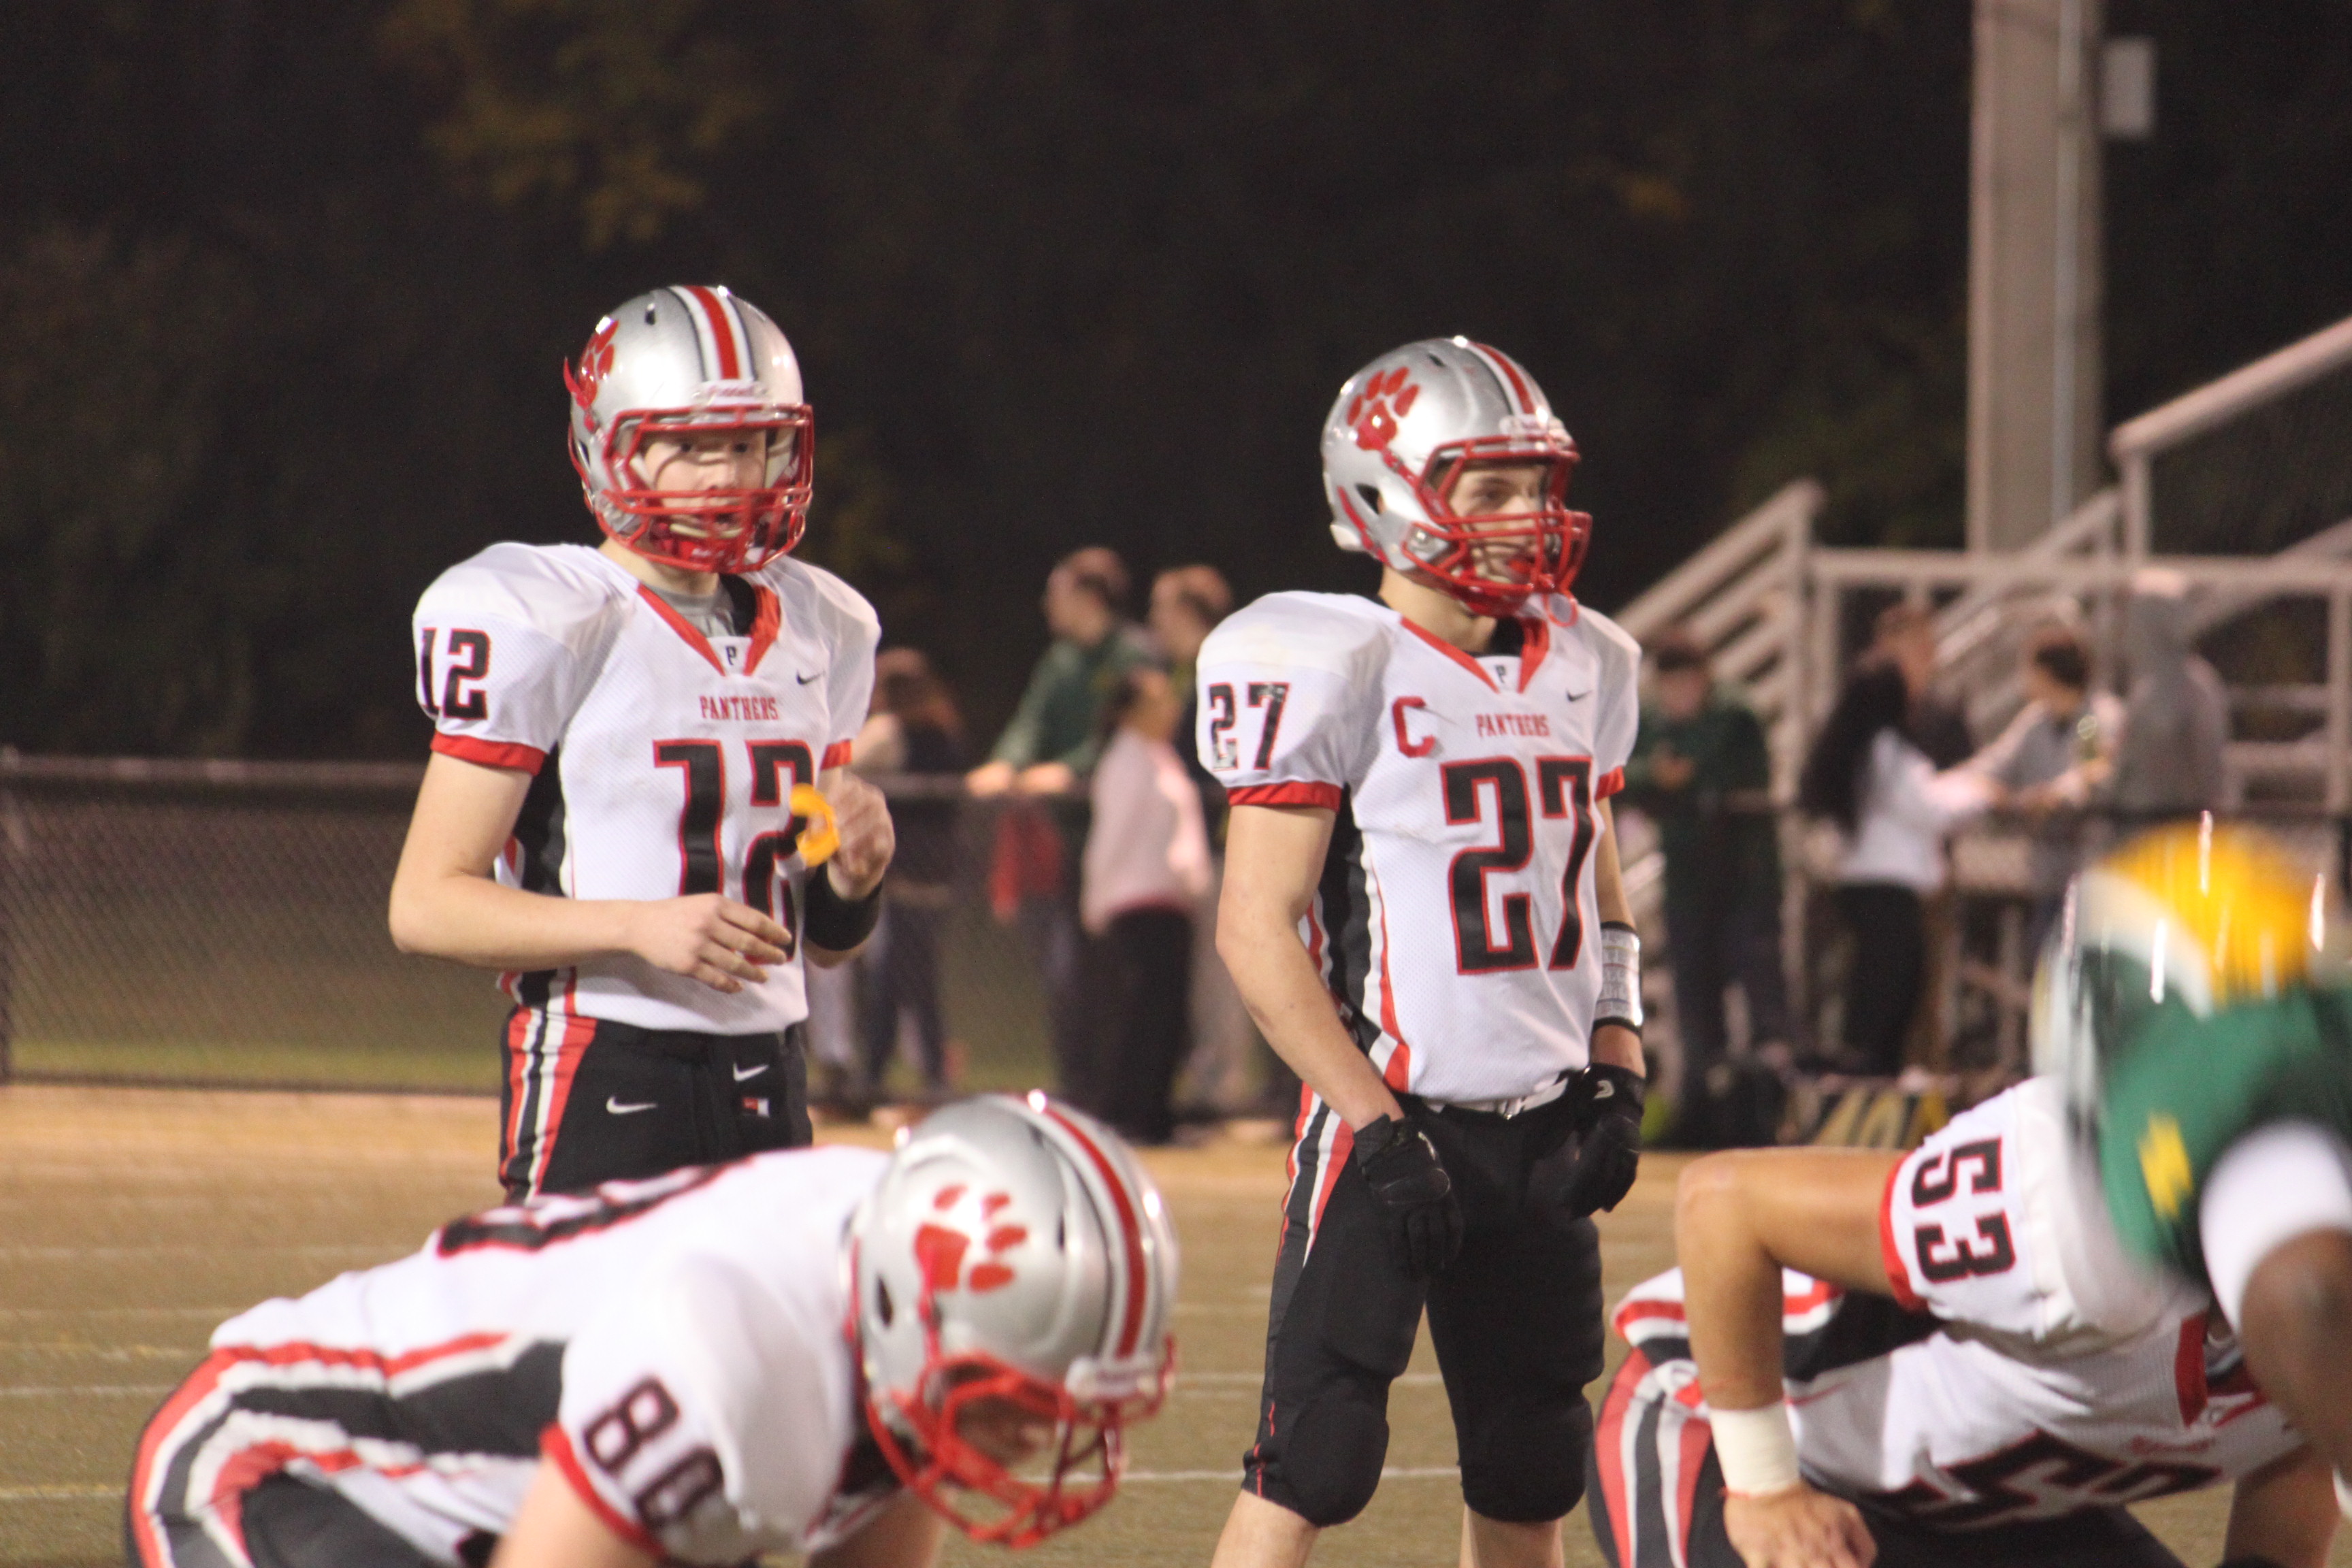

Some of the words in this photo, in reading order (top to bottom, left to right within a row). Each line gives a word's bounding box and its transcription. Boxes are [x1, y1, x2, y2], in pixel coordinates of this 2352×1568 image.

[421, 627, 491, 720] 12
[725, 645, 737, 666] P
[699, 695, 779, 721] PANTHERS
[1208, 682, 1290, 772] 27
[1392, 696, 1435, 759] C
[1475, 713, 1550, 738] PANTHERS
[653, 739, 815, 964] 12
[1439, 754, 1595, 976] 27
[1910, 1135, 2016, 1285] 53
[581, 1373, 724, 1531] 80
